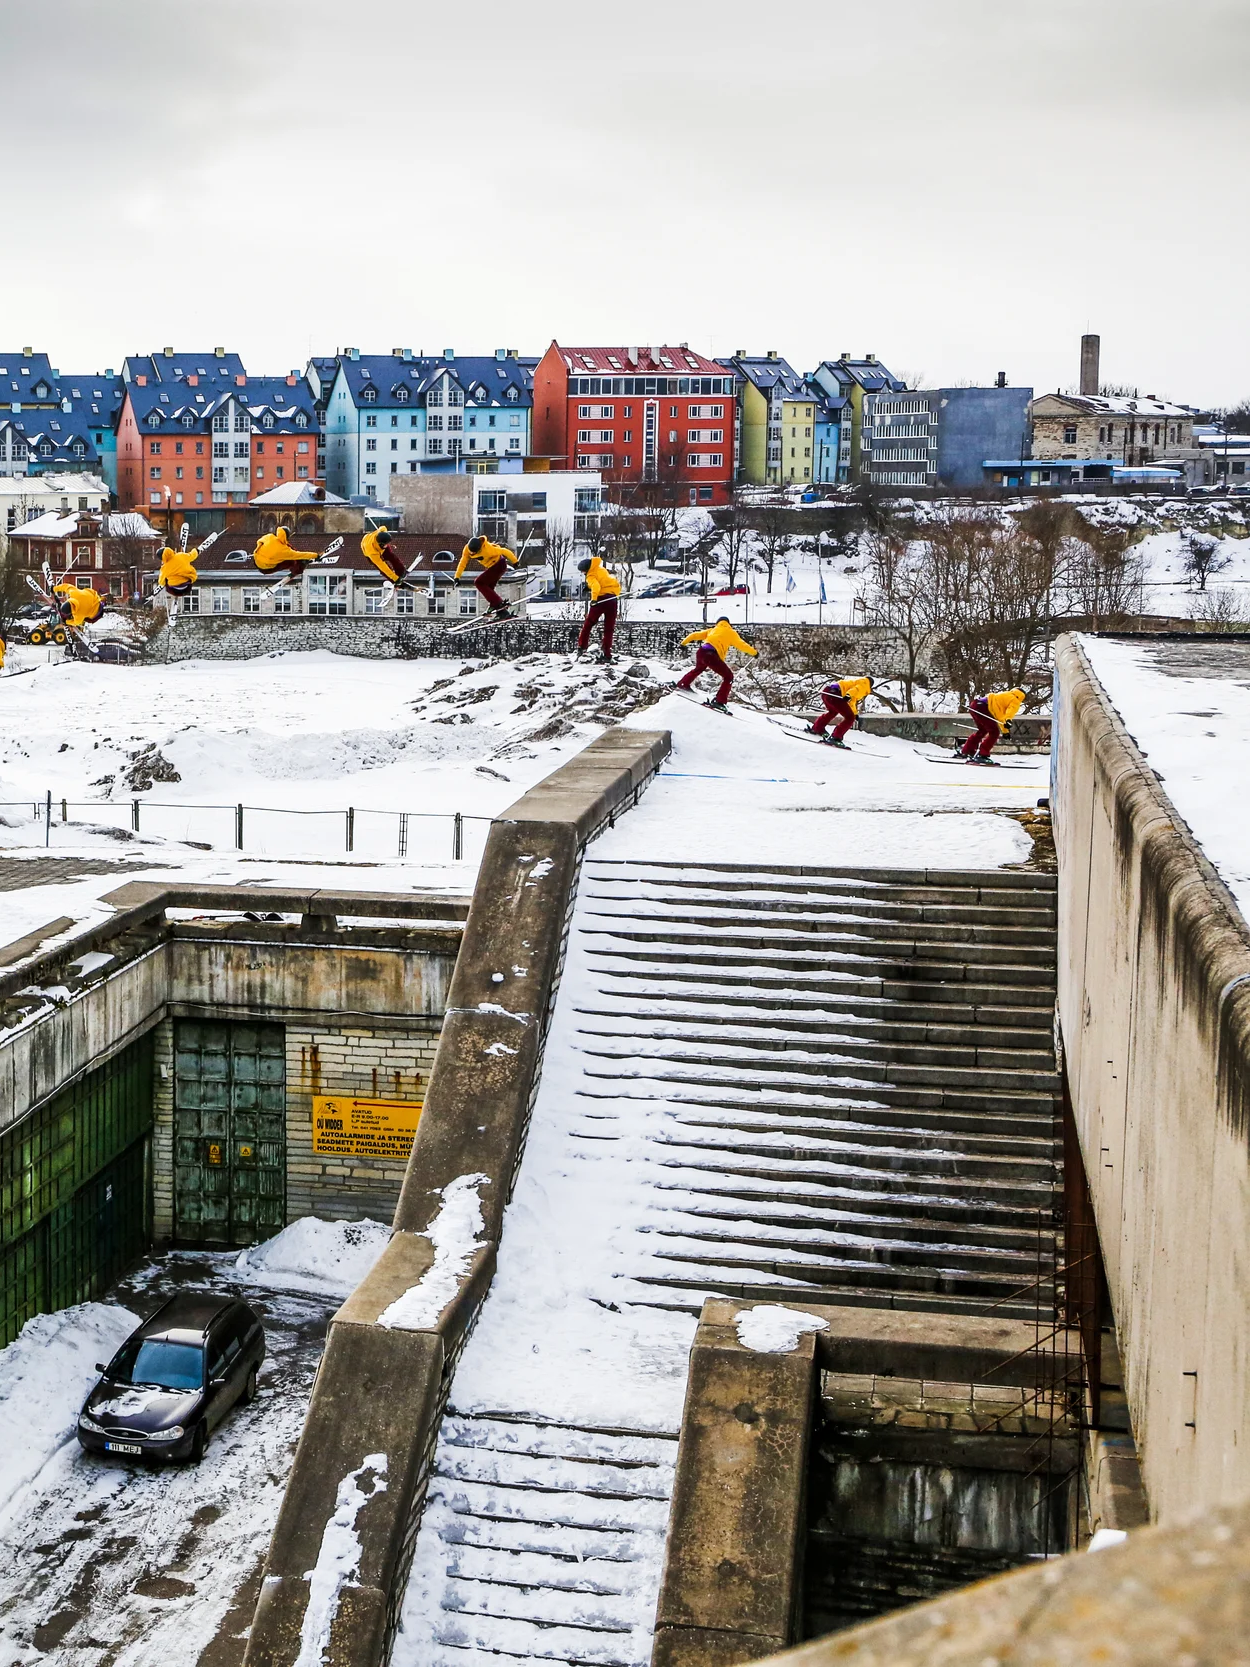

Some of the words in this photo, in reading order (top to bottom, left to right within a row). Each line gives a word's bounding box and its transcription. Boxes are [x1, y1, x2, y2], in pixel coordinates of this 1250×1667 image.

[325, 1118, 343, 1130] WIDDER
[320, 1131, 375, 1140] AUTOALARMIDE
[317, 1138, 354, 1146] SEADMETE
[356, 1140, 398, 1149] PAIGALDUS,
[317, 1145, 353, 1153] HOOLDUS.
[123, 1445, 139, 1454] MEJ
